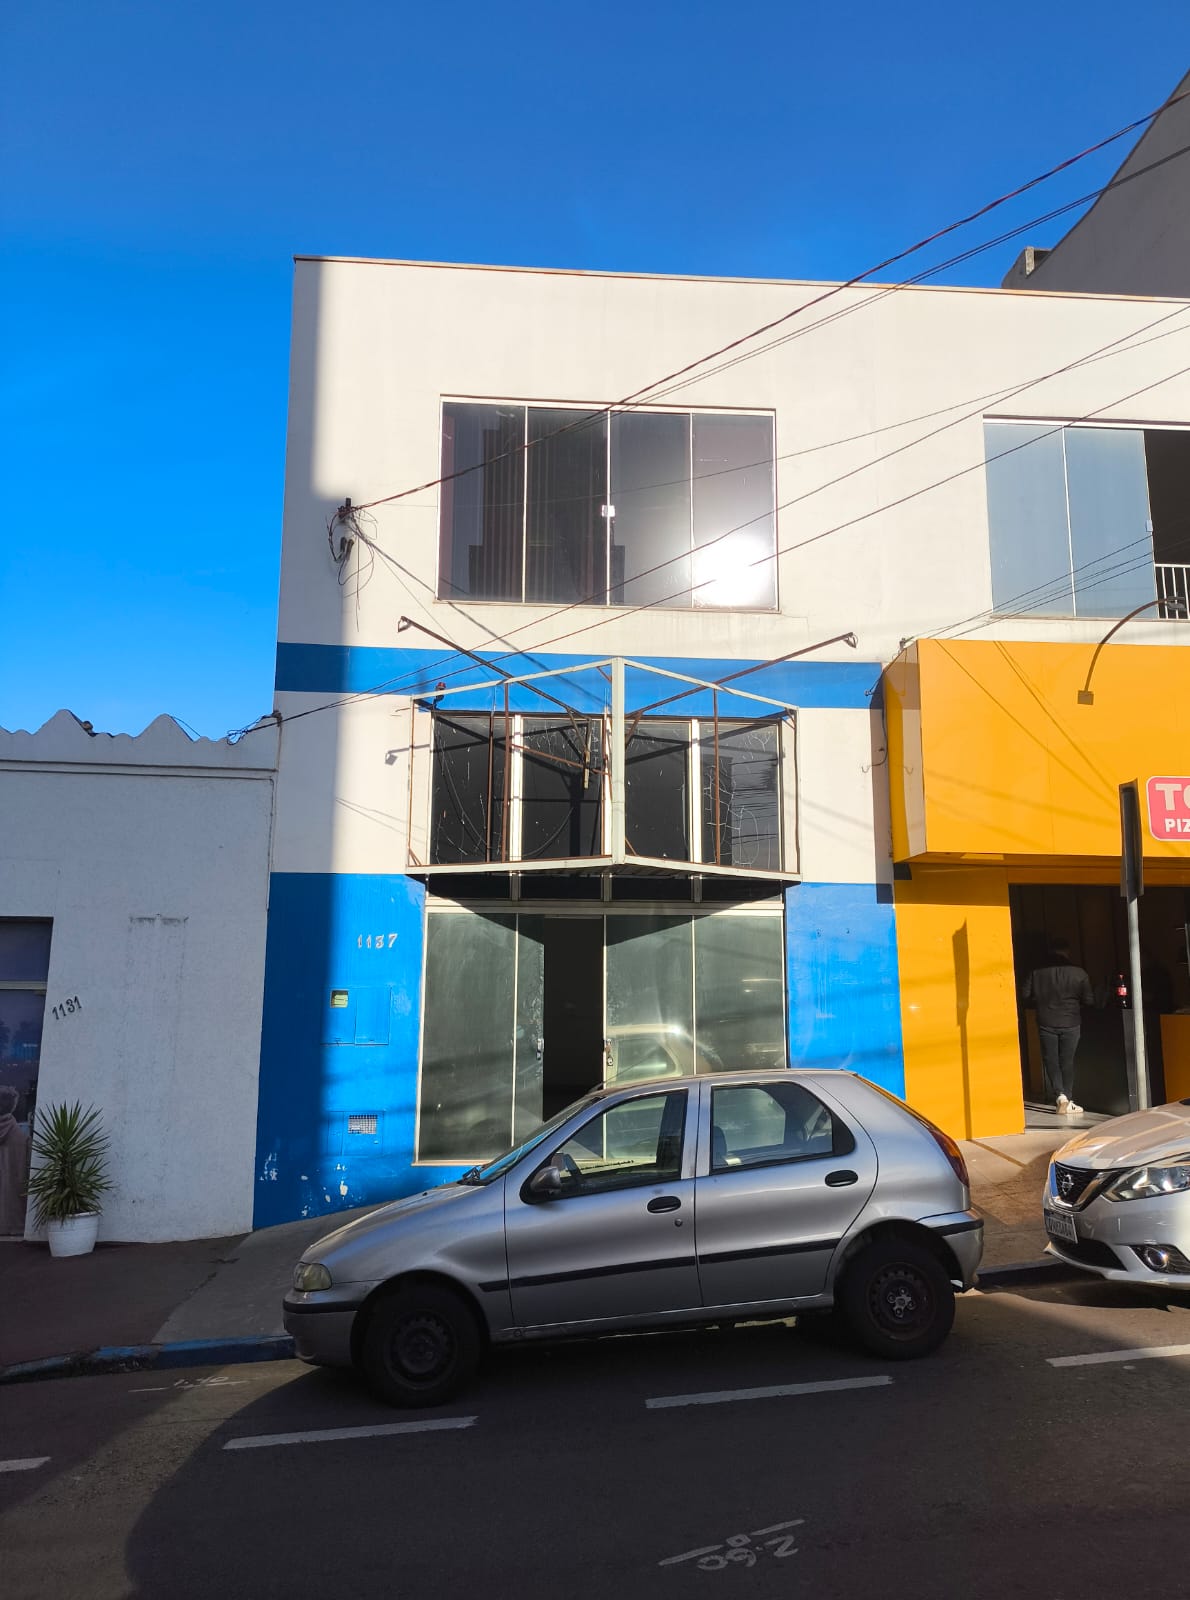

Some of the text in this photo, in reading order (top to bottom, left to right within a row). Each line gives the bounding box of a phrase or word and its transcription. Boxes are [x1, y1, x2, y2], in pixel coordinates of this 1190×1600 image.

[1155, 783, 1190, 811] T
[357, 932, 398, 949] 1137
[52, 995, 82, 1020] 1131
